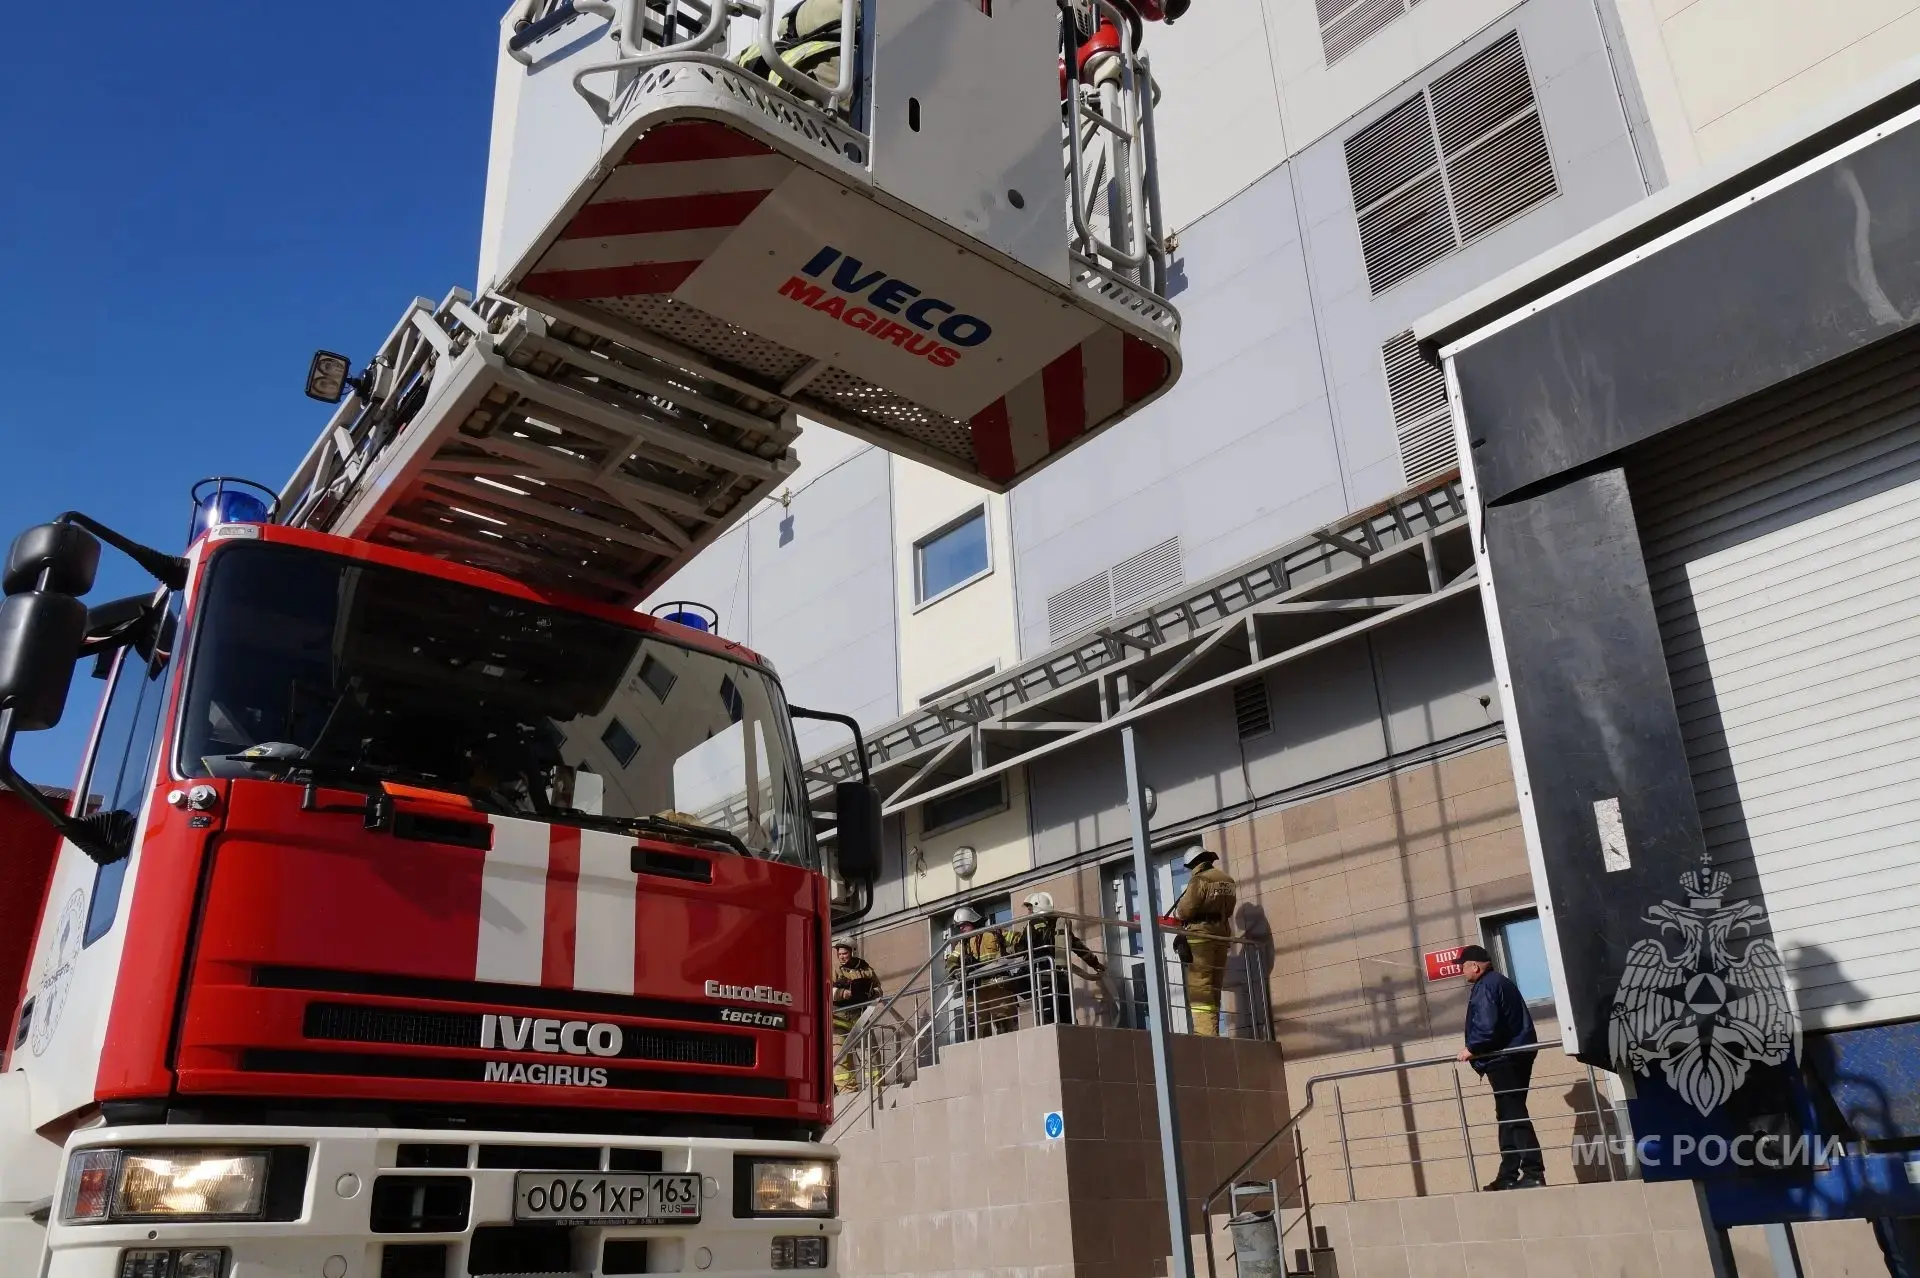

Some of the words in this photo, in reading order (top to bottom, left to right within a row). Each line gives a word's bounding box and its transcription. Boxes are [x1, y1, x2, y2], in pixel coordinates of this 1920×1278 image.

[801, 245, 992, 347] IVECO
[777, 275, 962, 368] MAGIRUS
[1436, 949, 1459, 963] ЦПУ
[720, 1008, 783, 1027] tector
[480, 1014, 623, 1057] IVECO
[484, 1062, 608, 1087] MAGIRUS
[652, 1178, 692, 1203] 163
[660, 1203, 681, 1213] RUS
